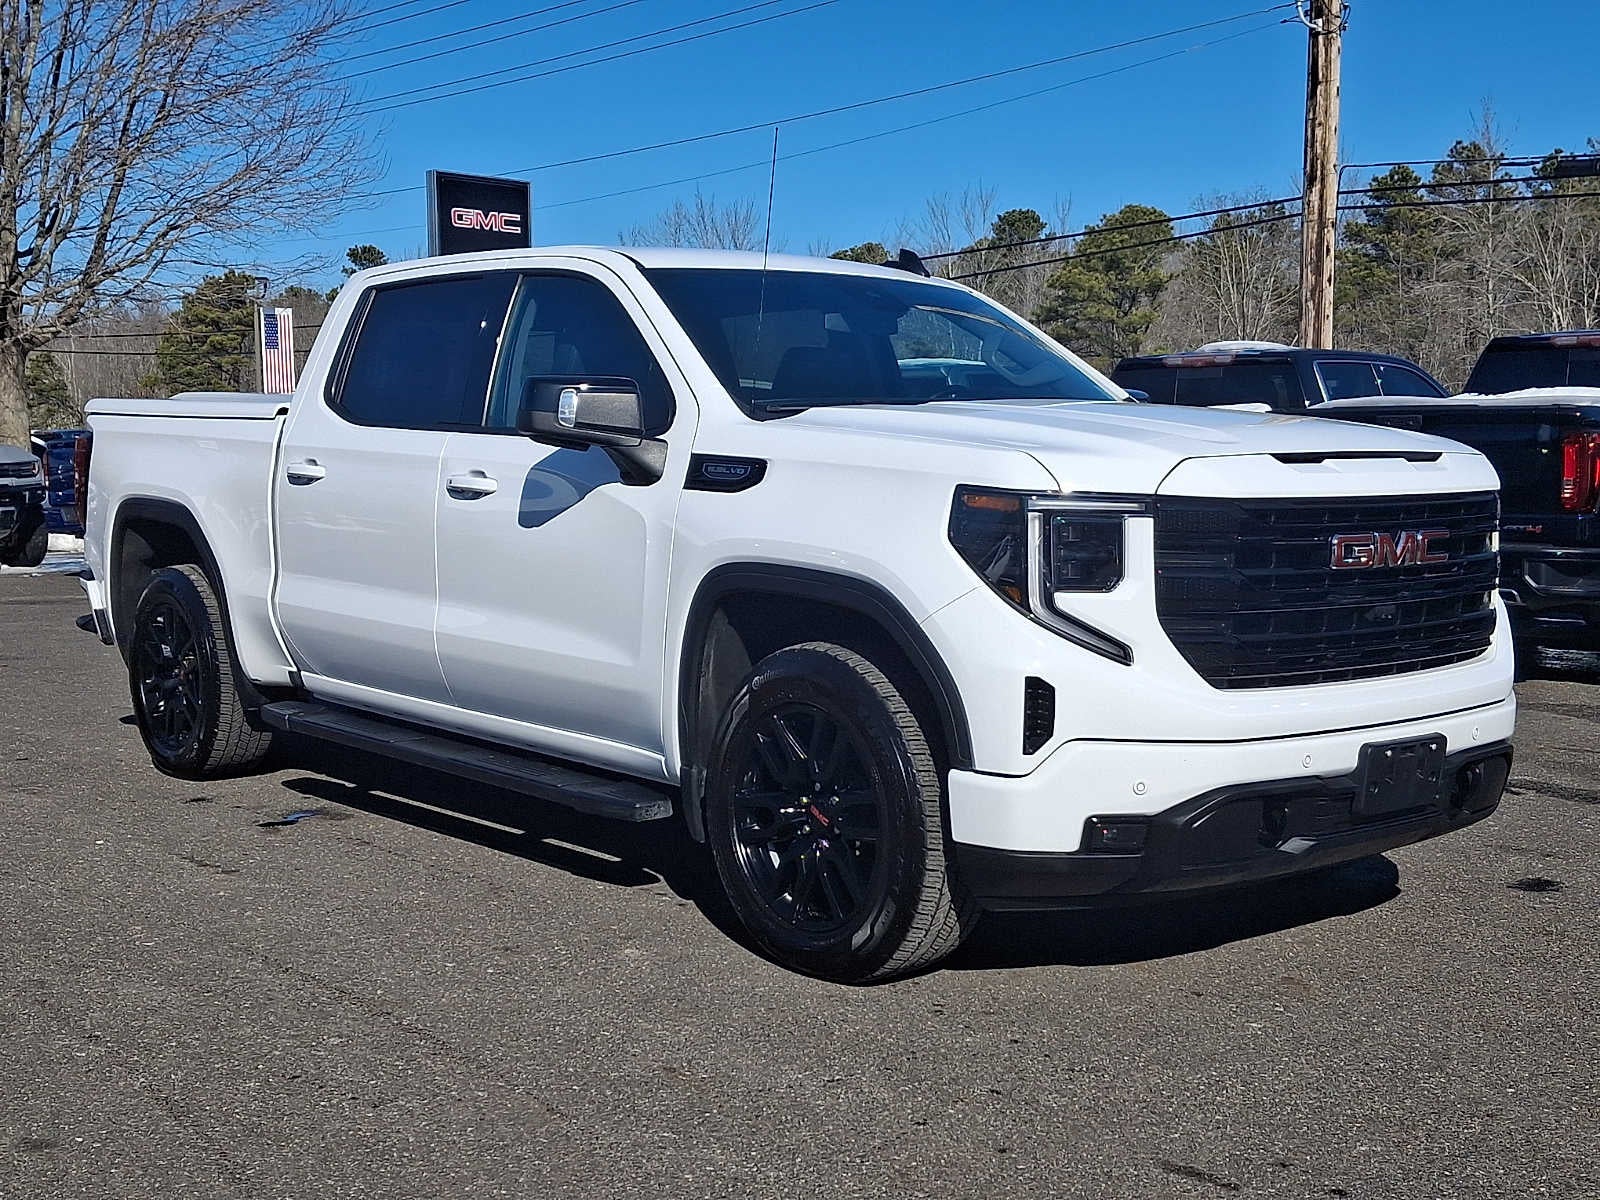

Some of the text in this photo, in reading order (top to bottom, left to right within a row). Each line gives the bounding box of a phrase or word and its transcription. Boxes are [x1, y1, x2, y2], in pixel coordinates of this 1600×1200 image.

[451, 208, 521, 233] GMC
[1330, 530, 1450, 570] GMC
[810, 804, 829, 827] GMC
